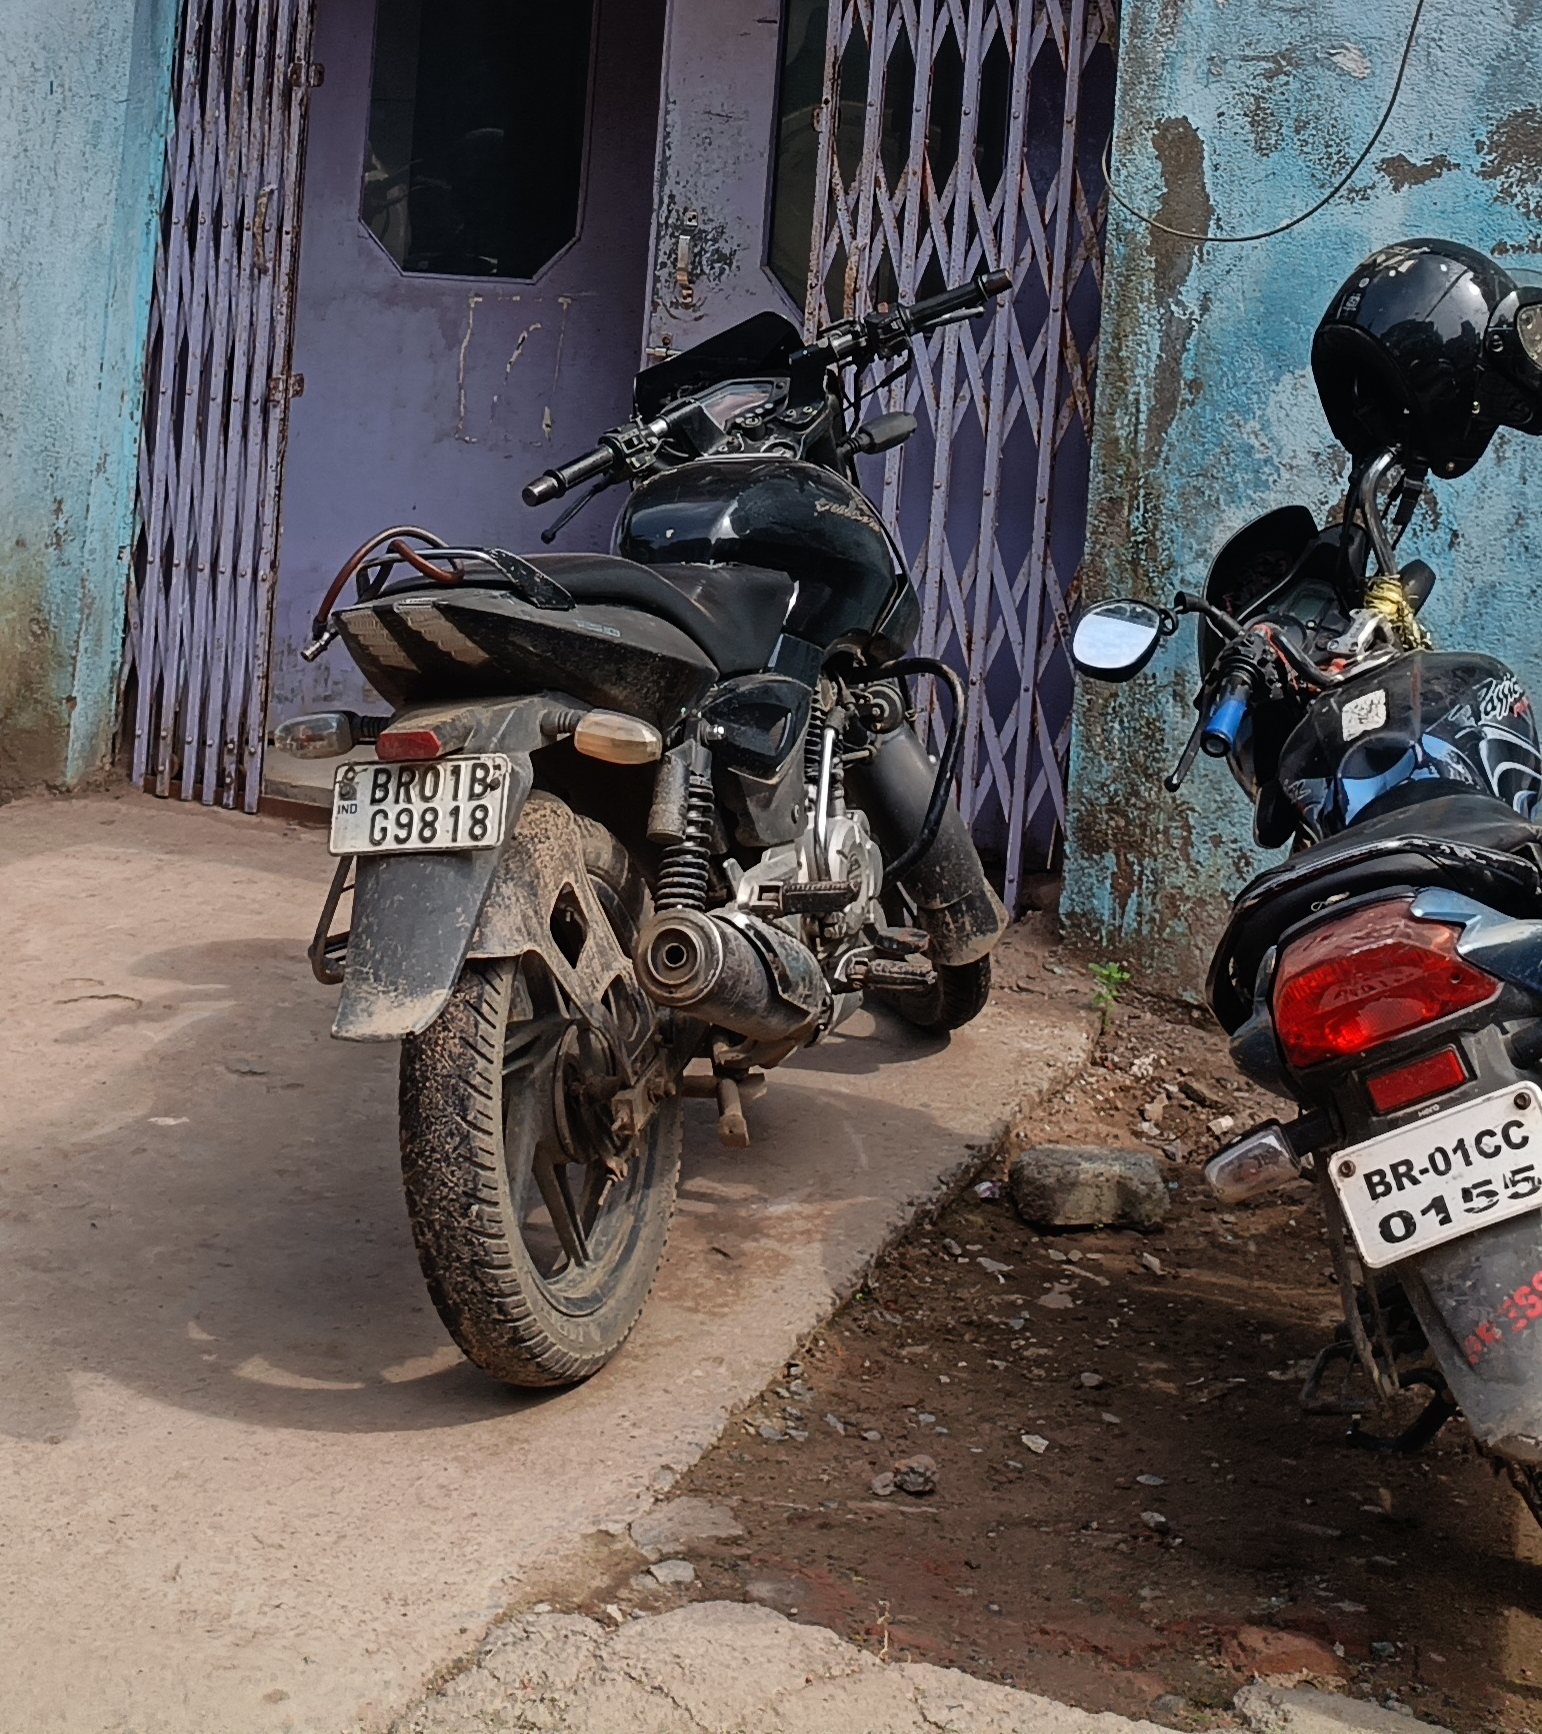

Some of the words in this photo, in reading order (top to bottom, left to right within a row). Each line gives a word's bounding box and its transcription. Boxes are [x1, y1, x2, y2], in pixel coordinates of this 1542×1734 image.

[370, 762, 493, 806] BR01B
[337, 803, 358, 815] IND
[369, 803, 490, 847] G9818
[1362, 1119, 1530, 1201] BR-01CC
[1378, 1164, 1542, 1244] 0155
